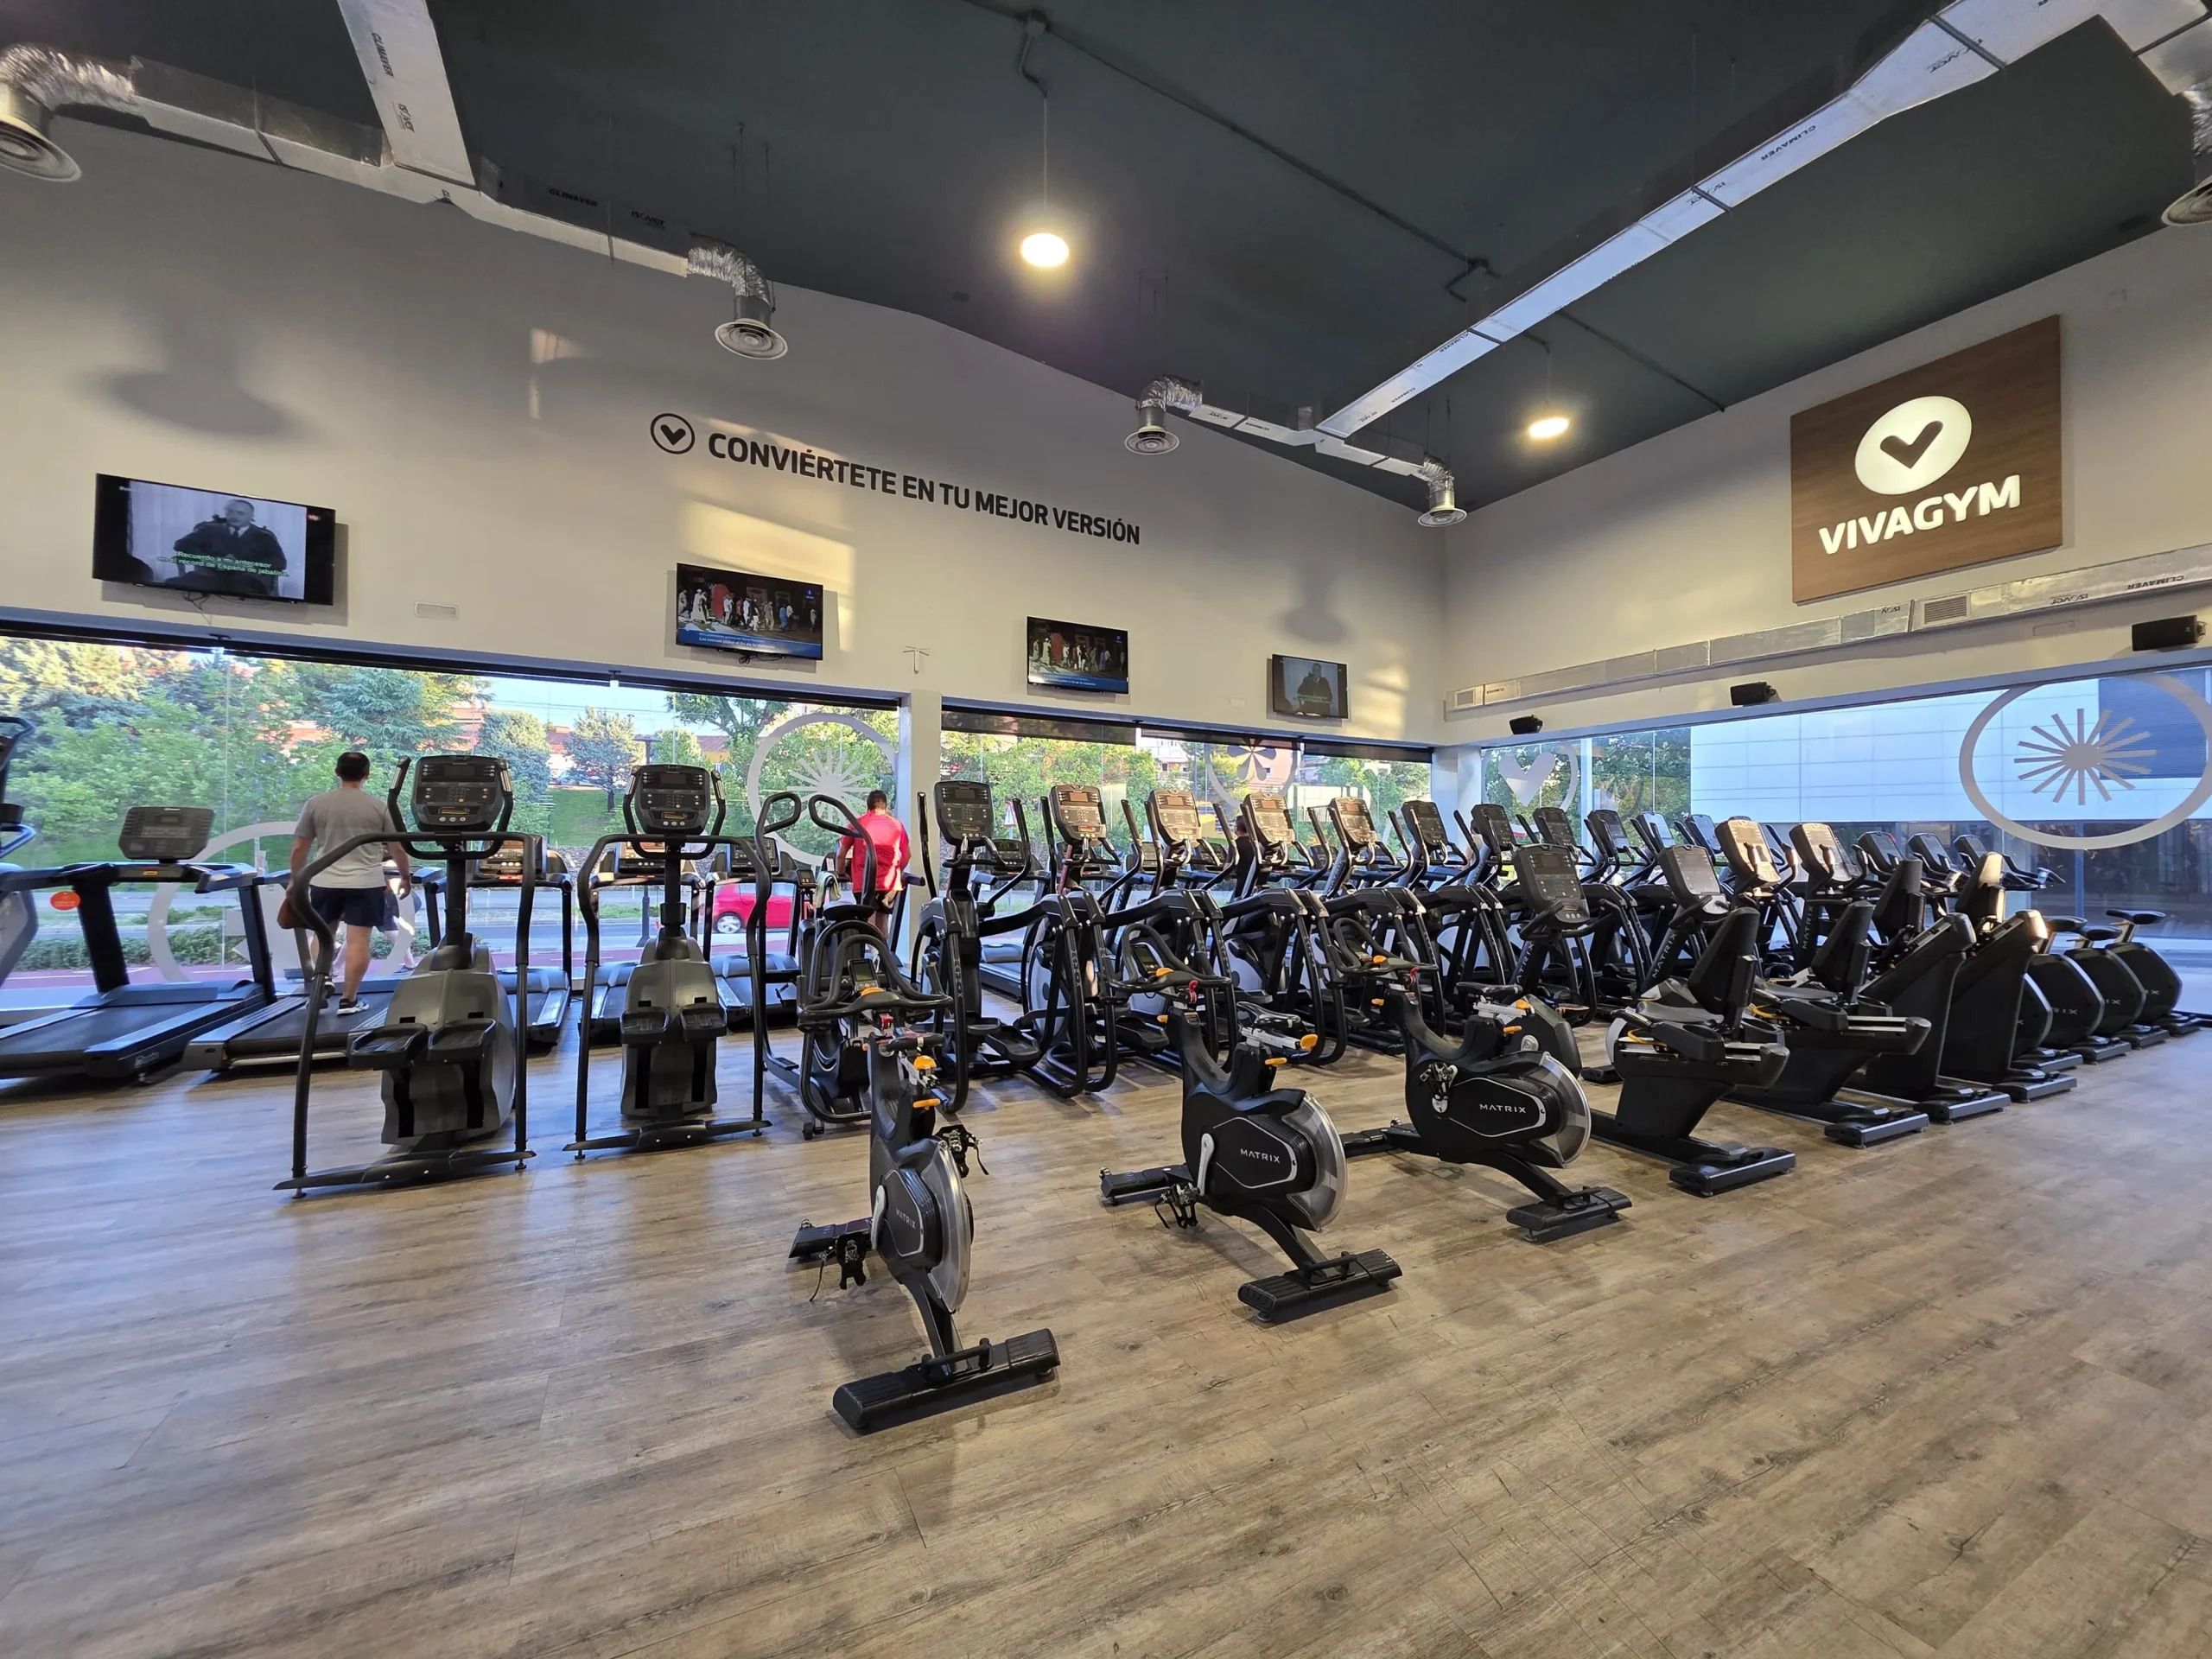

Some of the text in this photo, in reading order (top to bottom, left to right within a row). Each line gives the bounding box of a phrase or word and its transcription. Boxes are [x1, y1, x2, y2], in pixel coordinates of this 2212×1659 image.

[1761, 125, 1816, 161] CLIMAVER
[709, 433, 1141, 544] CONVIÉRTETE EN TU MEJOR VERSIÓN
[1818, 474, 2021, 555] VIVAGYM
[2127, 575, 2185, 590] CLIMAVER
[1516, 943, 1535, 984] ATRIX
[1652, 933, 1677, 979] MATRIX
[1479, 1103, 1526, 1114] MATRIX
[1240, 1147, 1280, 1164] MATRIX
[895, 1208, 916, 1230] MATRIX
